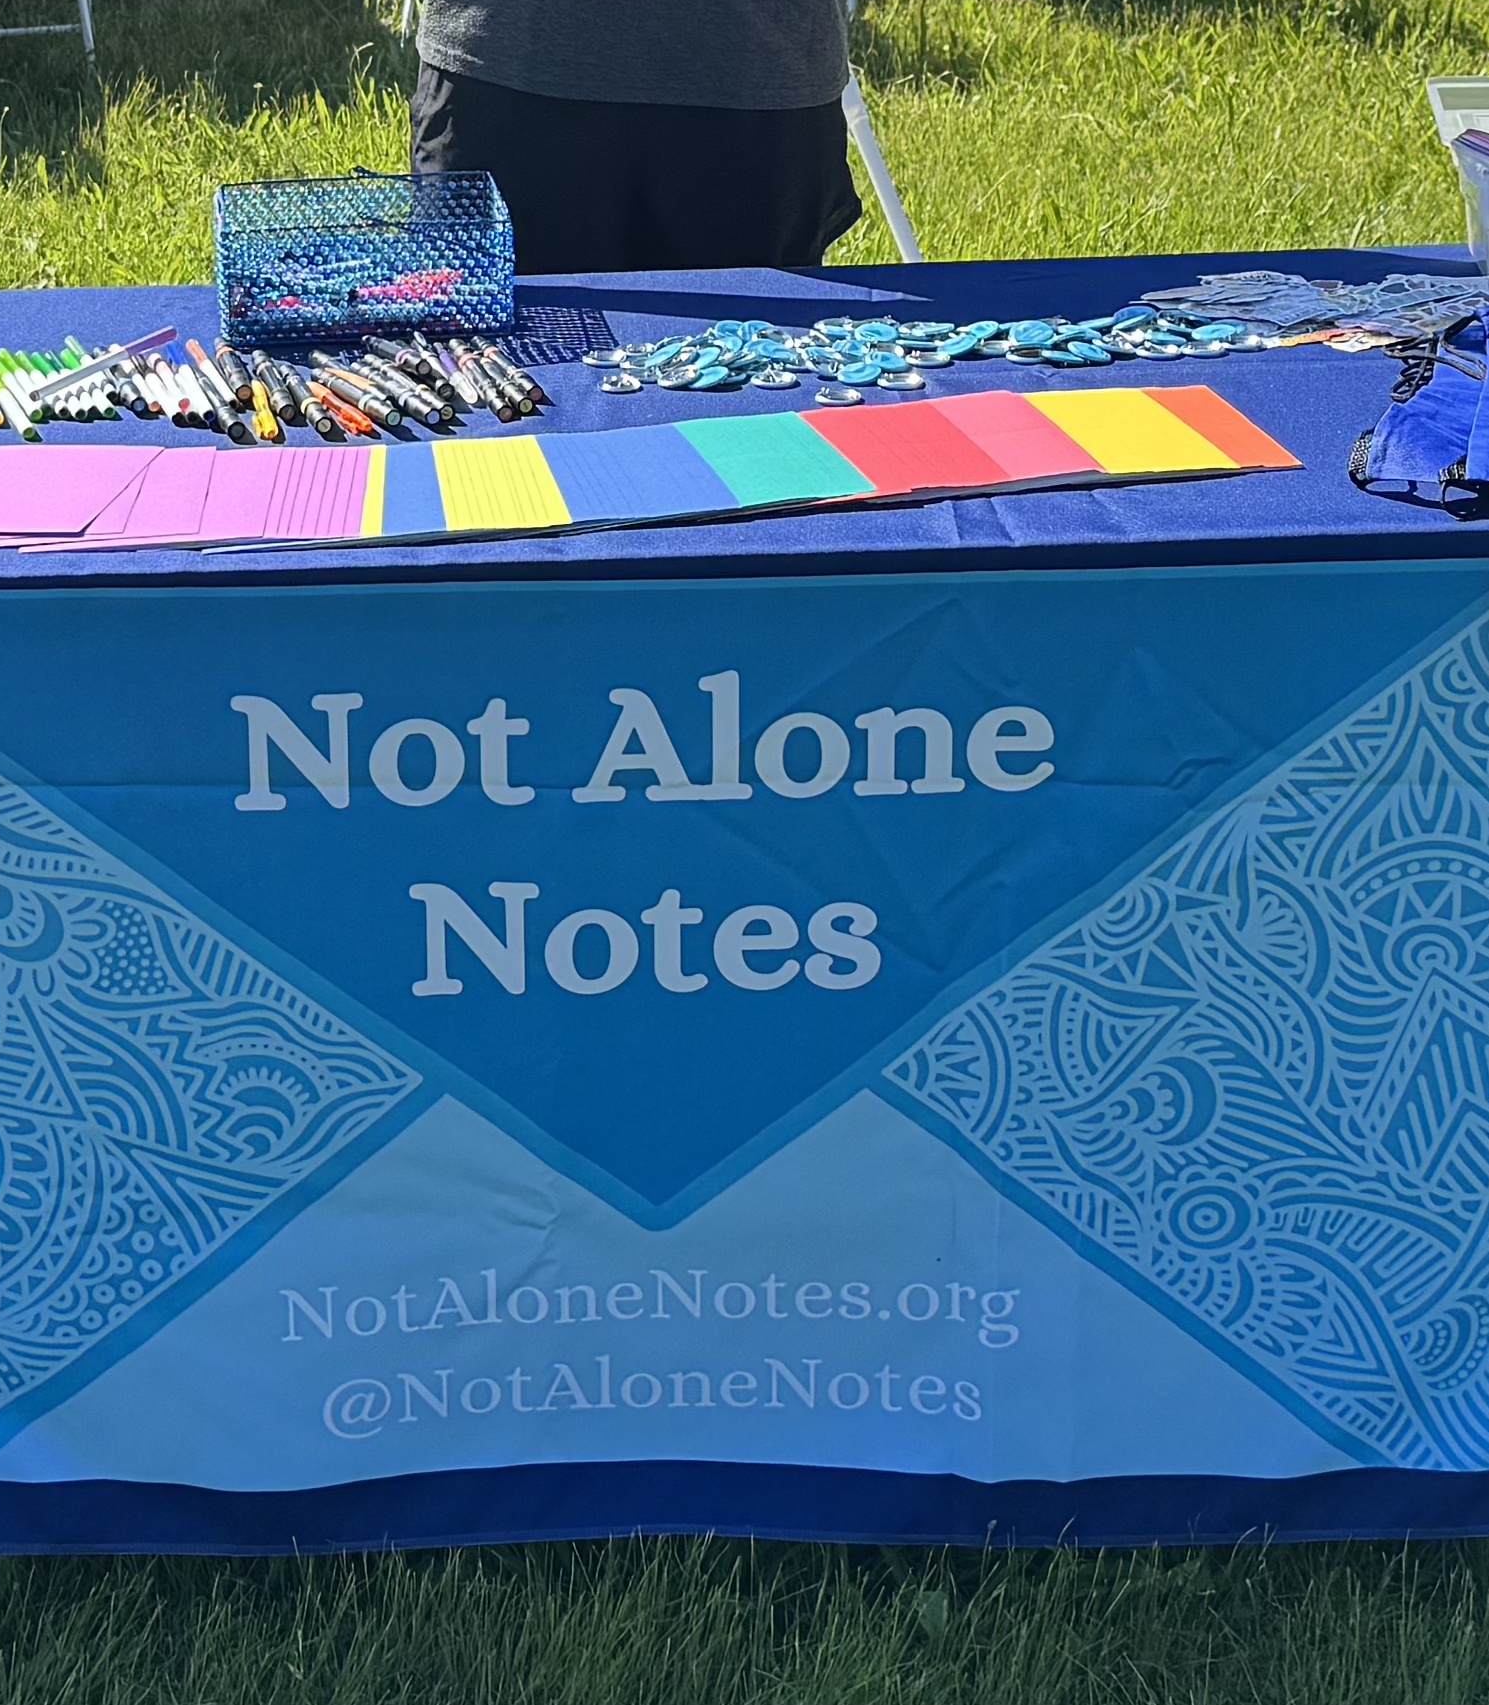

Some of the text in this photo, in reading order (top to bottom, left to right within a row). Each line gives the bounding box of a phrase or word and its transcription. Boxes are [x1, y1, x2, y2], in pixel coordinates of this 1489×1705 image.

[229, 669, 1056, 812] Not Alone
[408, 879, 882, 997] Notes
[280, 1268, 1021, 1349] NotAloneNotes.org
[322, 1355, 984, 1440] @NotAloneNotes
